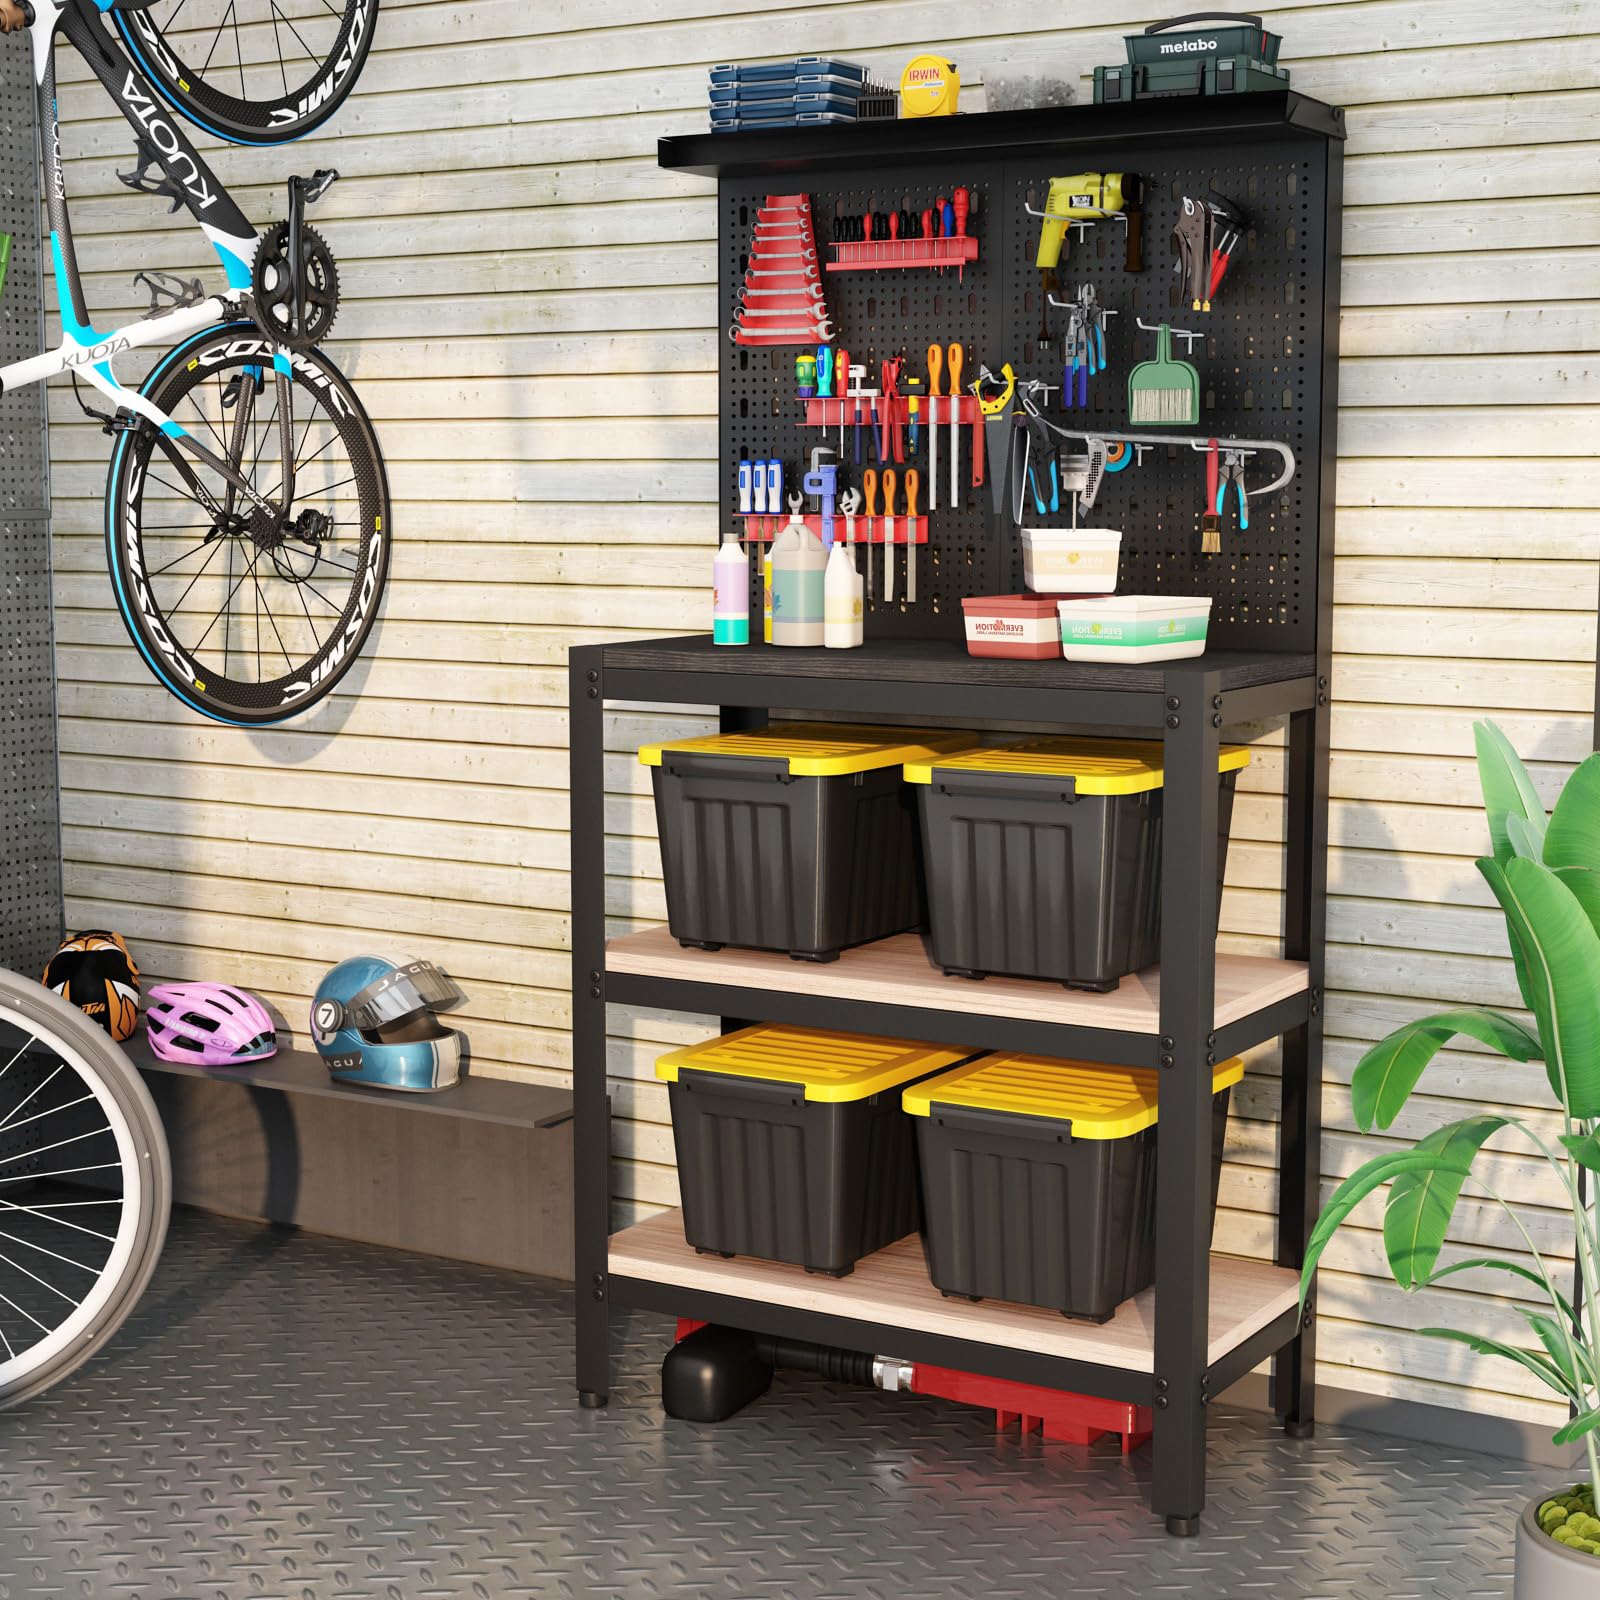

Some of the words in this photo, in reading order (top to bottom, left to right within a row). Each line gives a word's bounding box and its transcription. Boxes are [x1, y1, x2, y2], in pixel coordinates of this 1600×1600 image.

[1160, 39, 1217, 54] metabo
[909, 68, 940, 81] IRWIN
[122, 69, 217, 209] KUOTA
[61, 337, 130, 370] KUOTA
[321, 1008, 333, 1025] 7
